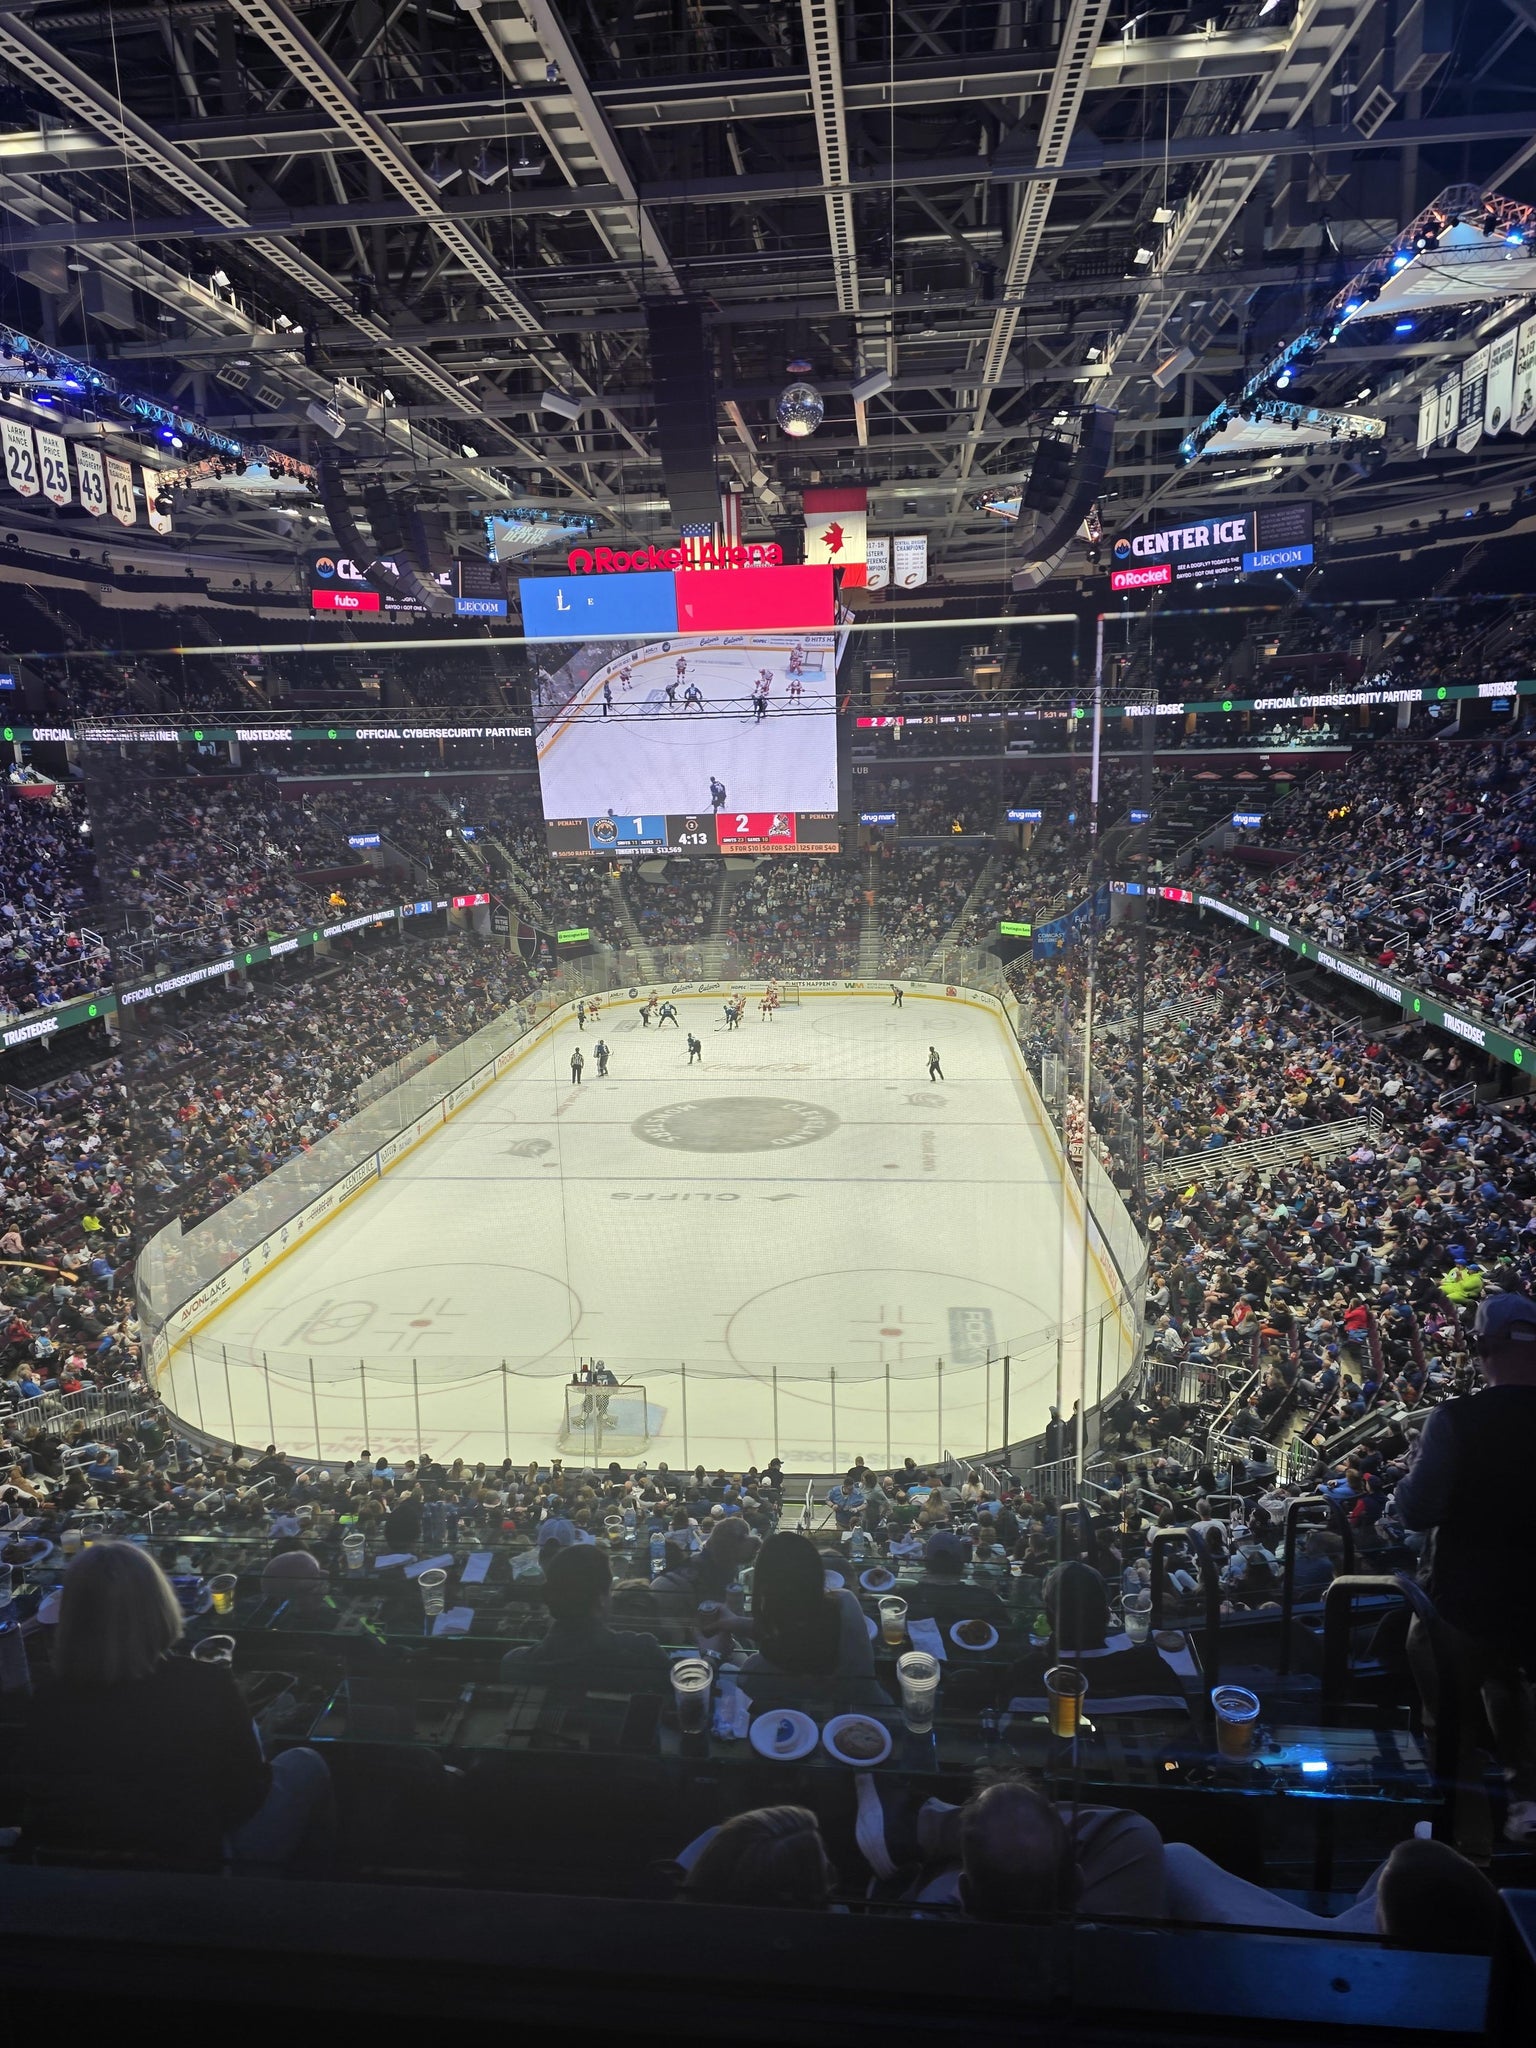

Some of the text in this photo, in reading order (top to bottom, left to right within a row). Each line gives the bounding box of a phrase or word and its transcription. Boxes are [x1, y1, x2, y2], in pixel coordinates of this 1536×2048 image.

[1444, 394, 1452, 429] 9
[6, 424, 26, 436] LARRY
[8, 434, 28, 448] NANCE
[42, 436, 59, 448] MARK
[44, 446, 61, 458] PRICE
[81, 450, 96, 460] BRAD
[8, 446, 35, 484] 22
[44, 457, 67, 492] 25
[82, 470, 102, 504] 43
[114, 482, 132, 513] 11
[511, 526, 534, 534] FEAR
[502, 533, 546, 544] DEPTHS
[1132, 526, 1210, 556] CENTER
[1214, 519, 1246, 544] ICE
[594, 543, 783, 573] Rocket Arena
[868, 574, 880, 586] C
[905, 573, 918, 585] C
[1126, 569, 1168, 584] Rocket
[334, 594, 359, 608] fubo
[556, 588, 594, 611] L E
[1478, 681, 1517, 697] TRUSTEDSEC
[1254, 689, 1422, 710] OFFICIAL CYBERSECURITY PARTNER
[1124, 704, 1184, 716] TRUSTEDSEC
[32, 728, 74, 740] OFFICIAL
[236, 730, 292, 741] TRUSTEDSEC
[356, 726, 532, 739] OFFICIAL CYBERSECURITY PARTNER
[861, 813, 878, 822] drug
[1008, 810, 1042, 819] drug mart
[1233, 814, 1248, 824] drug
[633, 817, 643, 835] 1
[736, 814, 749, 832] 2
[349, 836, 379, 846] drug mart
[679, 834, 707, 845] 4:13
[421, 903, 429, 911] 21
[457, 897, 465, 906] 10
[324, 925, 342, 938] OFFICIAL
[373, 909, 395, 922] PARTNER
[270, 939, 298, 955] TRUSTEDSEC
[122, 960, 234, 1005] OFFICIAL CYBERSECURITY PARTNER
[1318, 951, 1402, 1002] OFFICIAL CYBERSECURITY PARTNER
[3, 1017, 59, 1046] TRUSTEDSEC
[1443, 1012, 1486, 1046] TRUSTEDSEC
[643, 1104, 699, 1142] MONSTERS
[770, 1103, 826, 1145] CLEVELAND
[345, 1159, 374, 1189] CENTER ICE
[611, 1192, 741, 1201] CLIFFS
